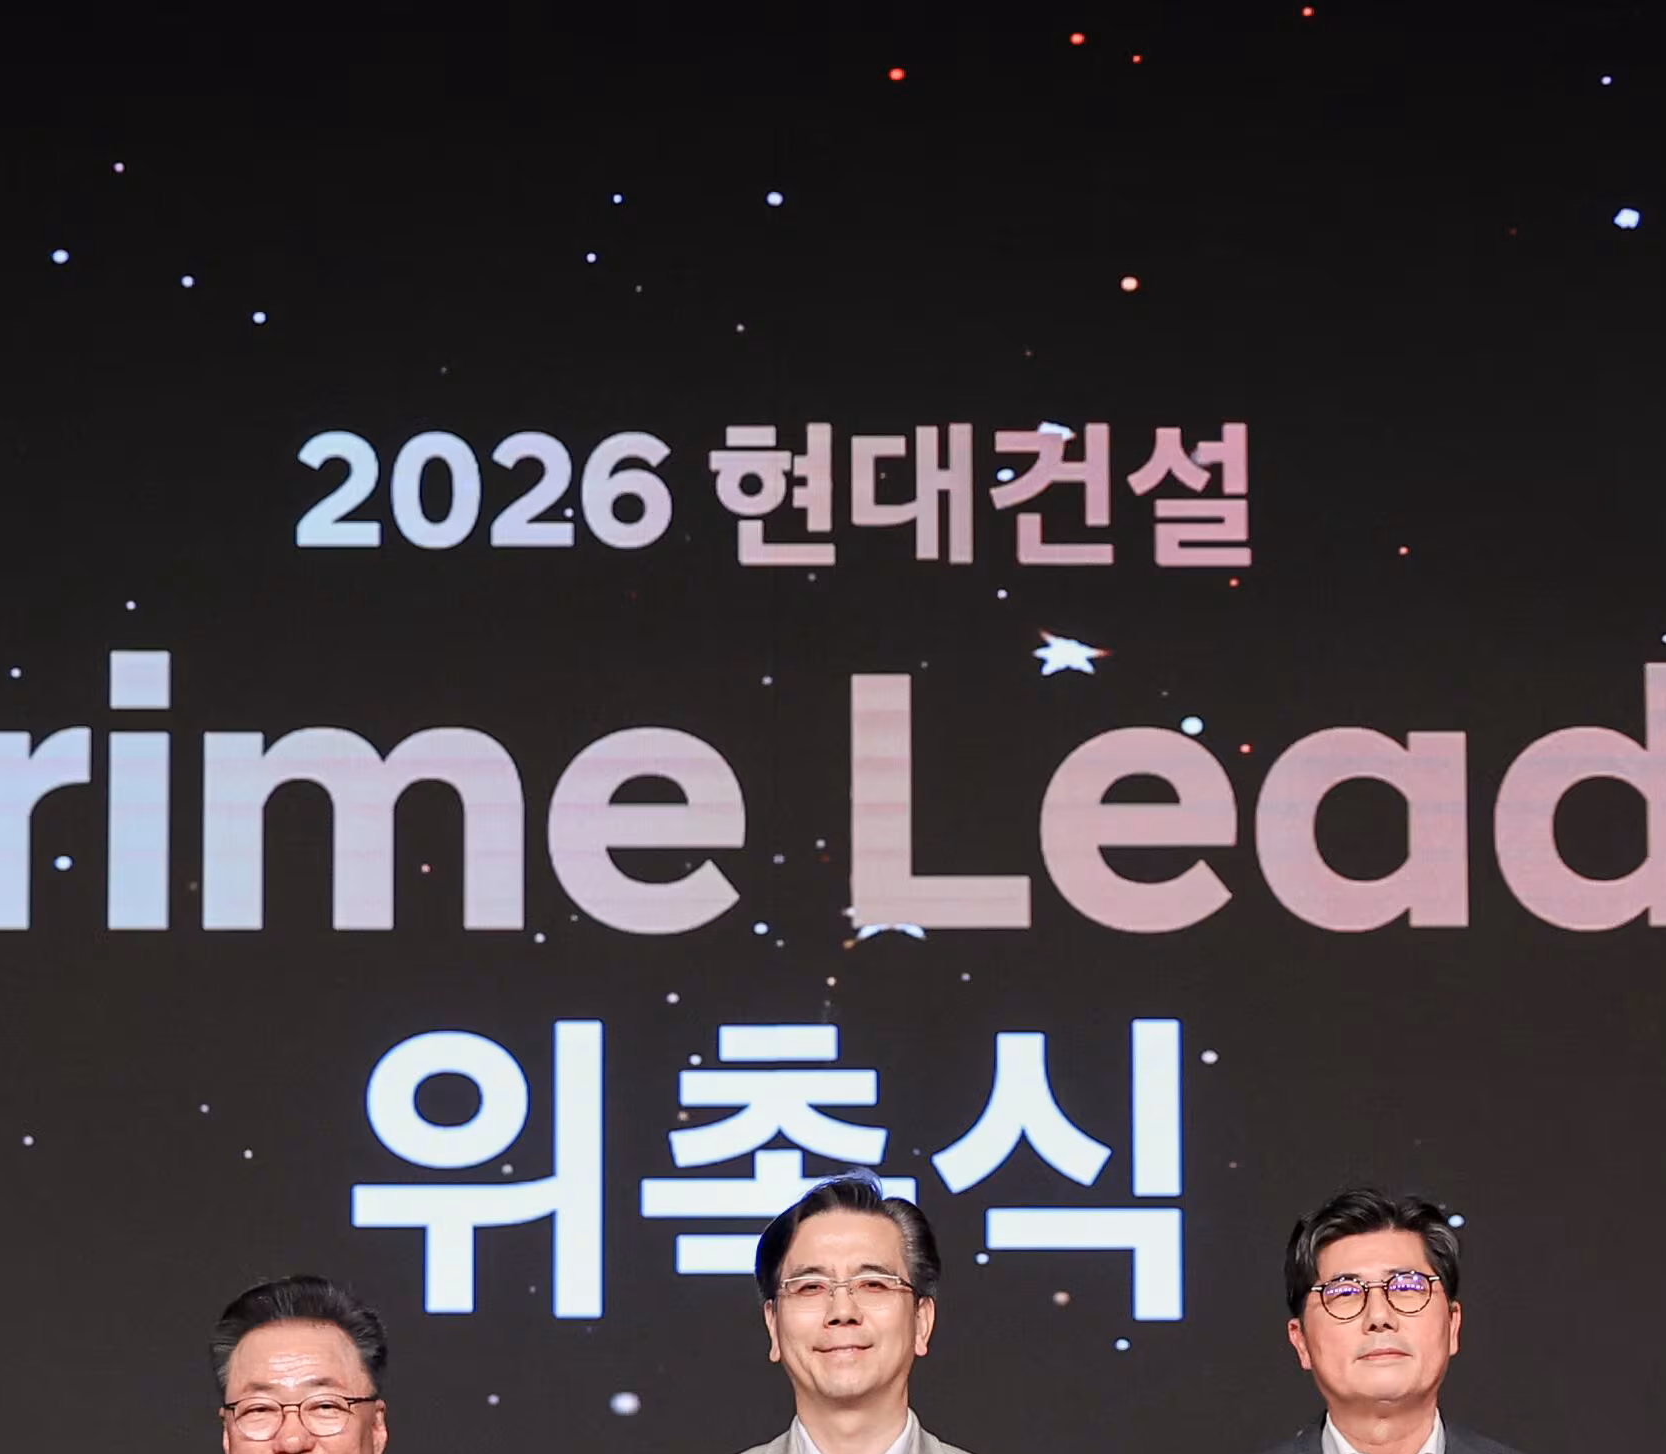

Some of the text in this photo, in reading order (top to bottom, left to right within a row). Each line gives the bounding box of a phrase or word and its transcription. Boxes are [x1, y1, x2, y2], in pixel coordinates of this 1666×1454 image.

[296, 421, 1253, 568] 2026 현대건설
[351, 1018, 1184, 1323] 위촉식
